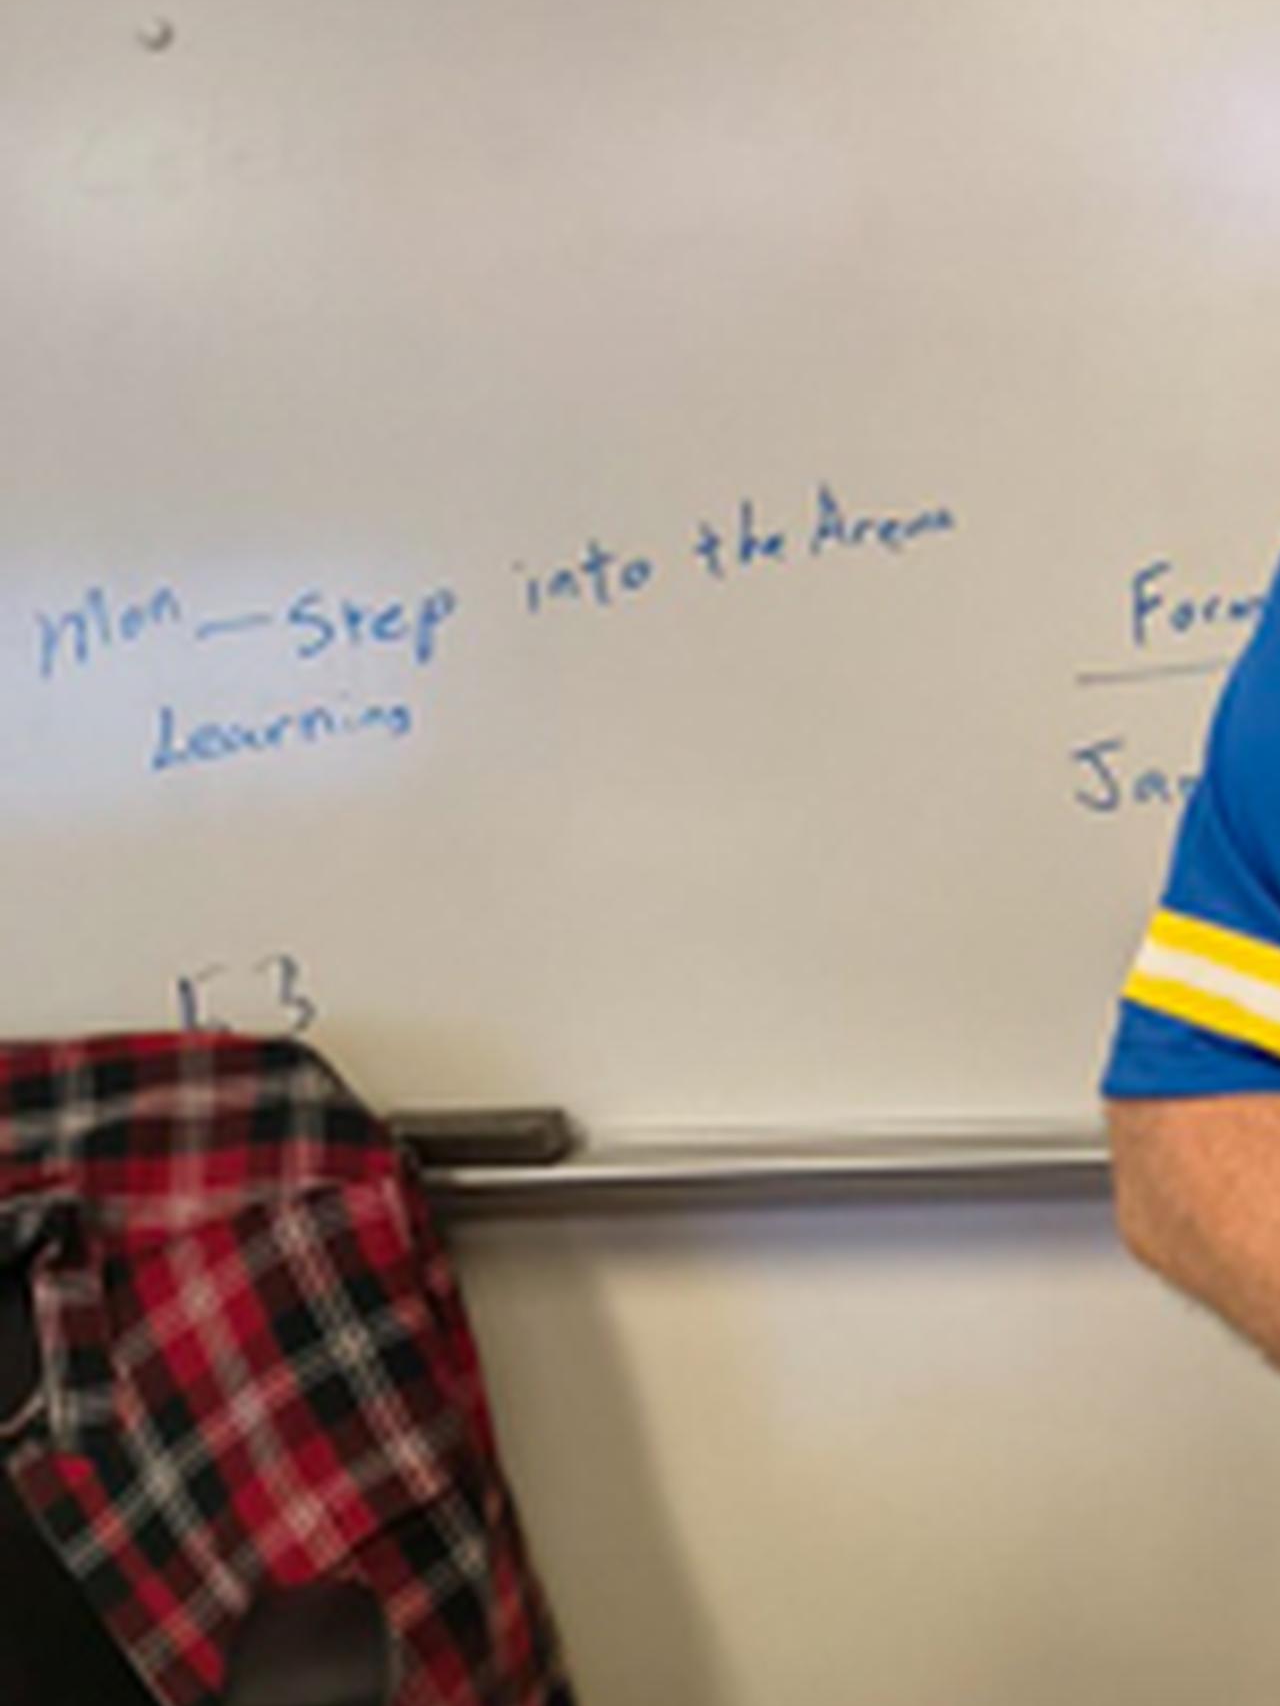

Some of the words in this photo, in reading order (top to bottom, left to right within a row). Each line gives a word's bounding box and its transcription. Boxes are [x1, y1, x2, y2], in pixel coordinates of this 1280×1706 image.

[287, 590, 458, 666] Step
[511, 539, 652, 615] into
[694, 499, 786, 581] the
[150, 703, 414, 772] Learning
